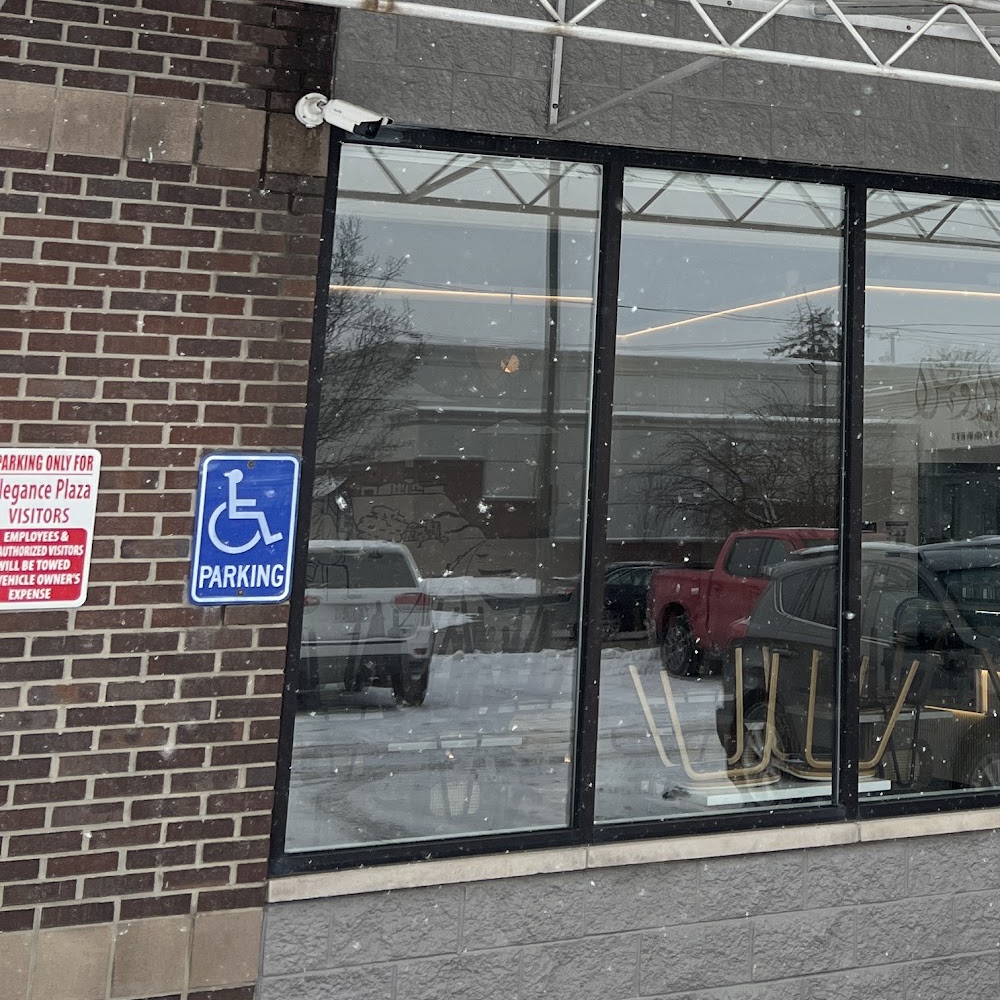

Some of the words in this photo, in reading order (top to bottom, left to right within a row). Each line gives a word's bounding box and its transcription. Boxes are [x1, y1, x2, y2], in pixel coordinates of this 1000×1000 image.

[0, 454, 43, 471] ARKING
[45, 454, 72, 471] ONLY
[73, 455, 94, 471] FOR
[0, 478, 52, 506] legance
[55, 478, 91, 500] Plaza
[9, 508, 70, 524] VISITORS
[3, 531, 60, 542] EMPLOYEES
[60, 531, 69, 542] &
[0, 545, 47, 557] UTHORIZED
[48, 544, 84, 556] VISITORS
[21, 559, 35, 571] BE
[36, 559, 71, 571] TOWED
[37, 573, 81, 585] OWNER'S
[198, 563, 285, 589] PARKING
[8, 588, 52, 600] EXPENSE
